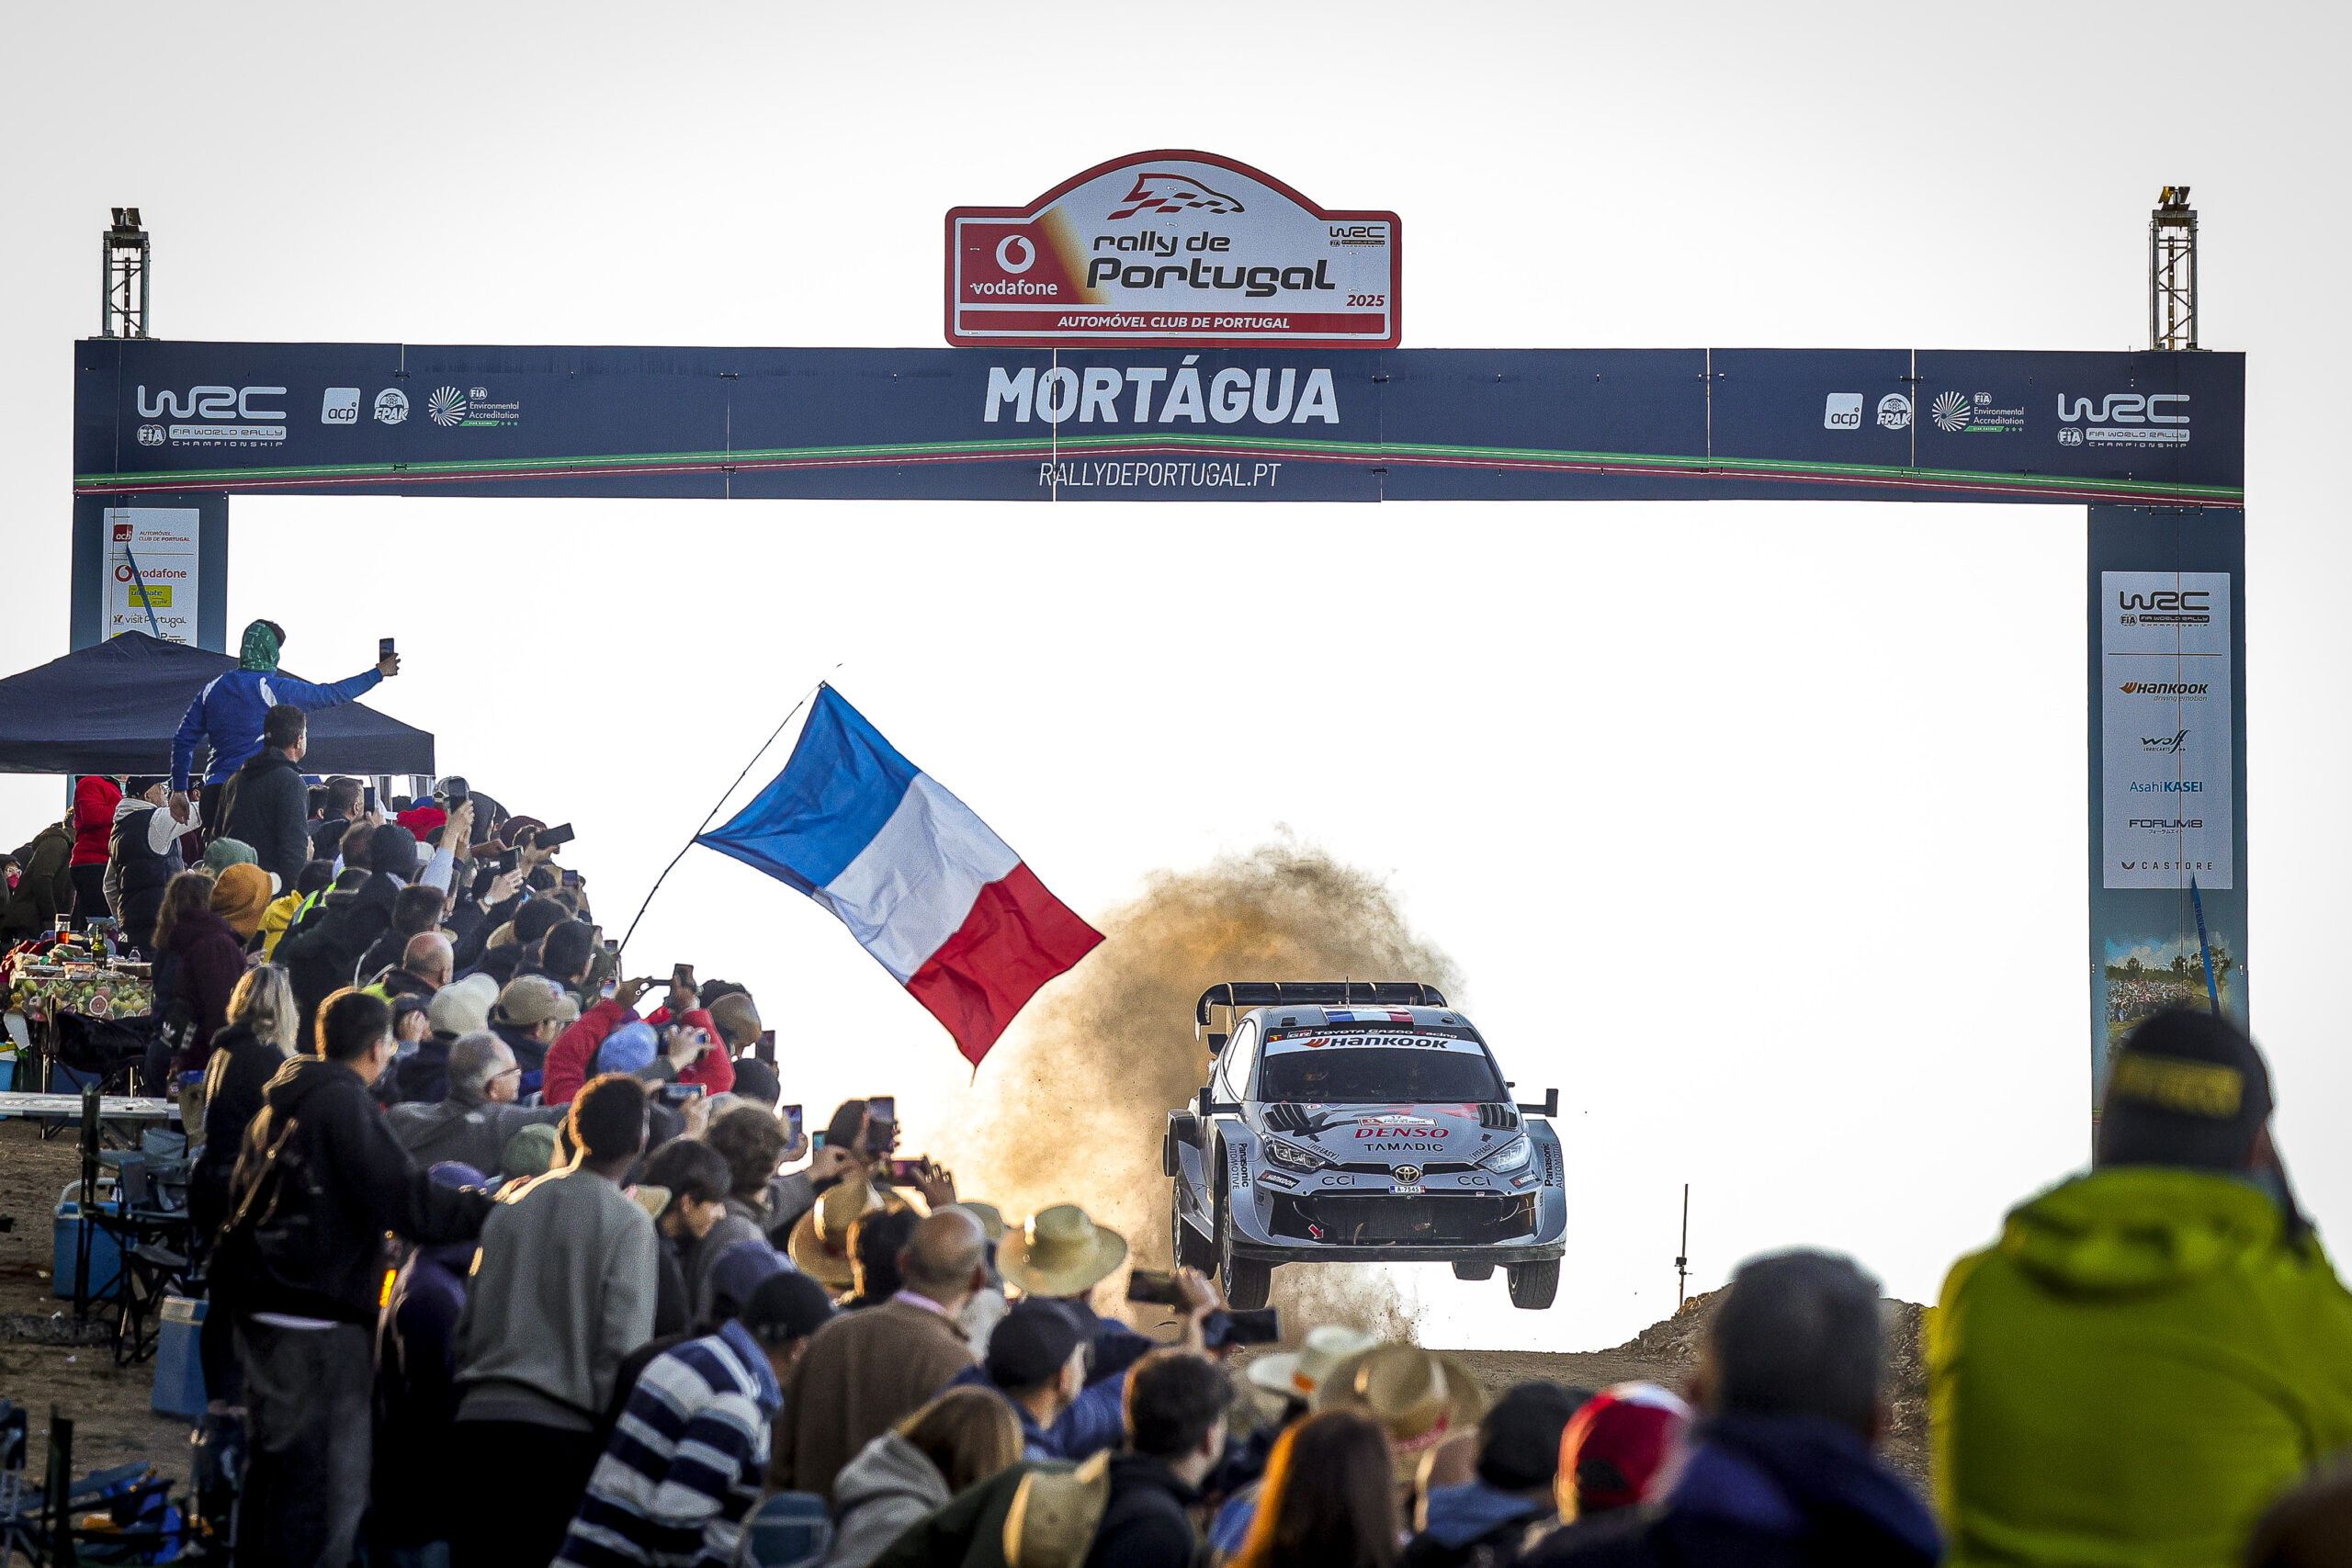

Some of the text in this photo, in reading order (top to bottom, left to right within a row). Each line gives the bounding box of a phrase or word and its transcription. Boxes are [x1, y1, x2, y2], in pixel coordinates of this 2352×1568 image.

[1329, 225, 1385, 238] WRC
[1093, 231, 1231, 257] rally de
[1086, 257, 1336, 298] Portugal
[972, 279, 1058, 296] vodafone
[1346, 294, 1385, 307] 2025
[1057, 313, 1290, 330] AUTOMÓVEL CLUB DE PORTUGAL
[983, 354, 1340, 424] MORTÁGUA
[138, 385, 288, 420] WRC
[469, 400, 520, 410] Environmental
[2057, 392, 2190, 423] WRC
[328, 408, 356, 421] acp
[373, 407, 410, 421] FPAK
[469, 411, 520, 419] Accreditation
[1973, 406, 2025, 415] Environmental
[1831, 413, 1859, 426] acp
[1876, 412, 1912, 425] FPAK
[1973, 415, 2025, 424] Accreditation
[1039, 462, 1282, 487] RALLYDEPORTUGAL.PT
[2120, 591, 2210, 611] WRC
[125, 615, 187, 628] visit Prtugal
[2154, 694, 2177, 703] driving
[2129, 819, 2203, 828] FORUM8
[2142, 862, 2213, 871] CASTORE
[1416, 1030, 1458, 1039] Racing
[1355, 1128, 1450, 1139] DENSO
[1363, 1143, 1444, 1152] TAMADIC
[1228, 1143, 1240, 1190] AUTOMOTIVE
[1238, 1143, 1250, 1188] Panasonic
[1543, 1143, 1554, 1187] Panasonic
